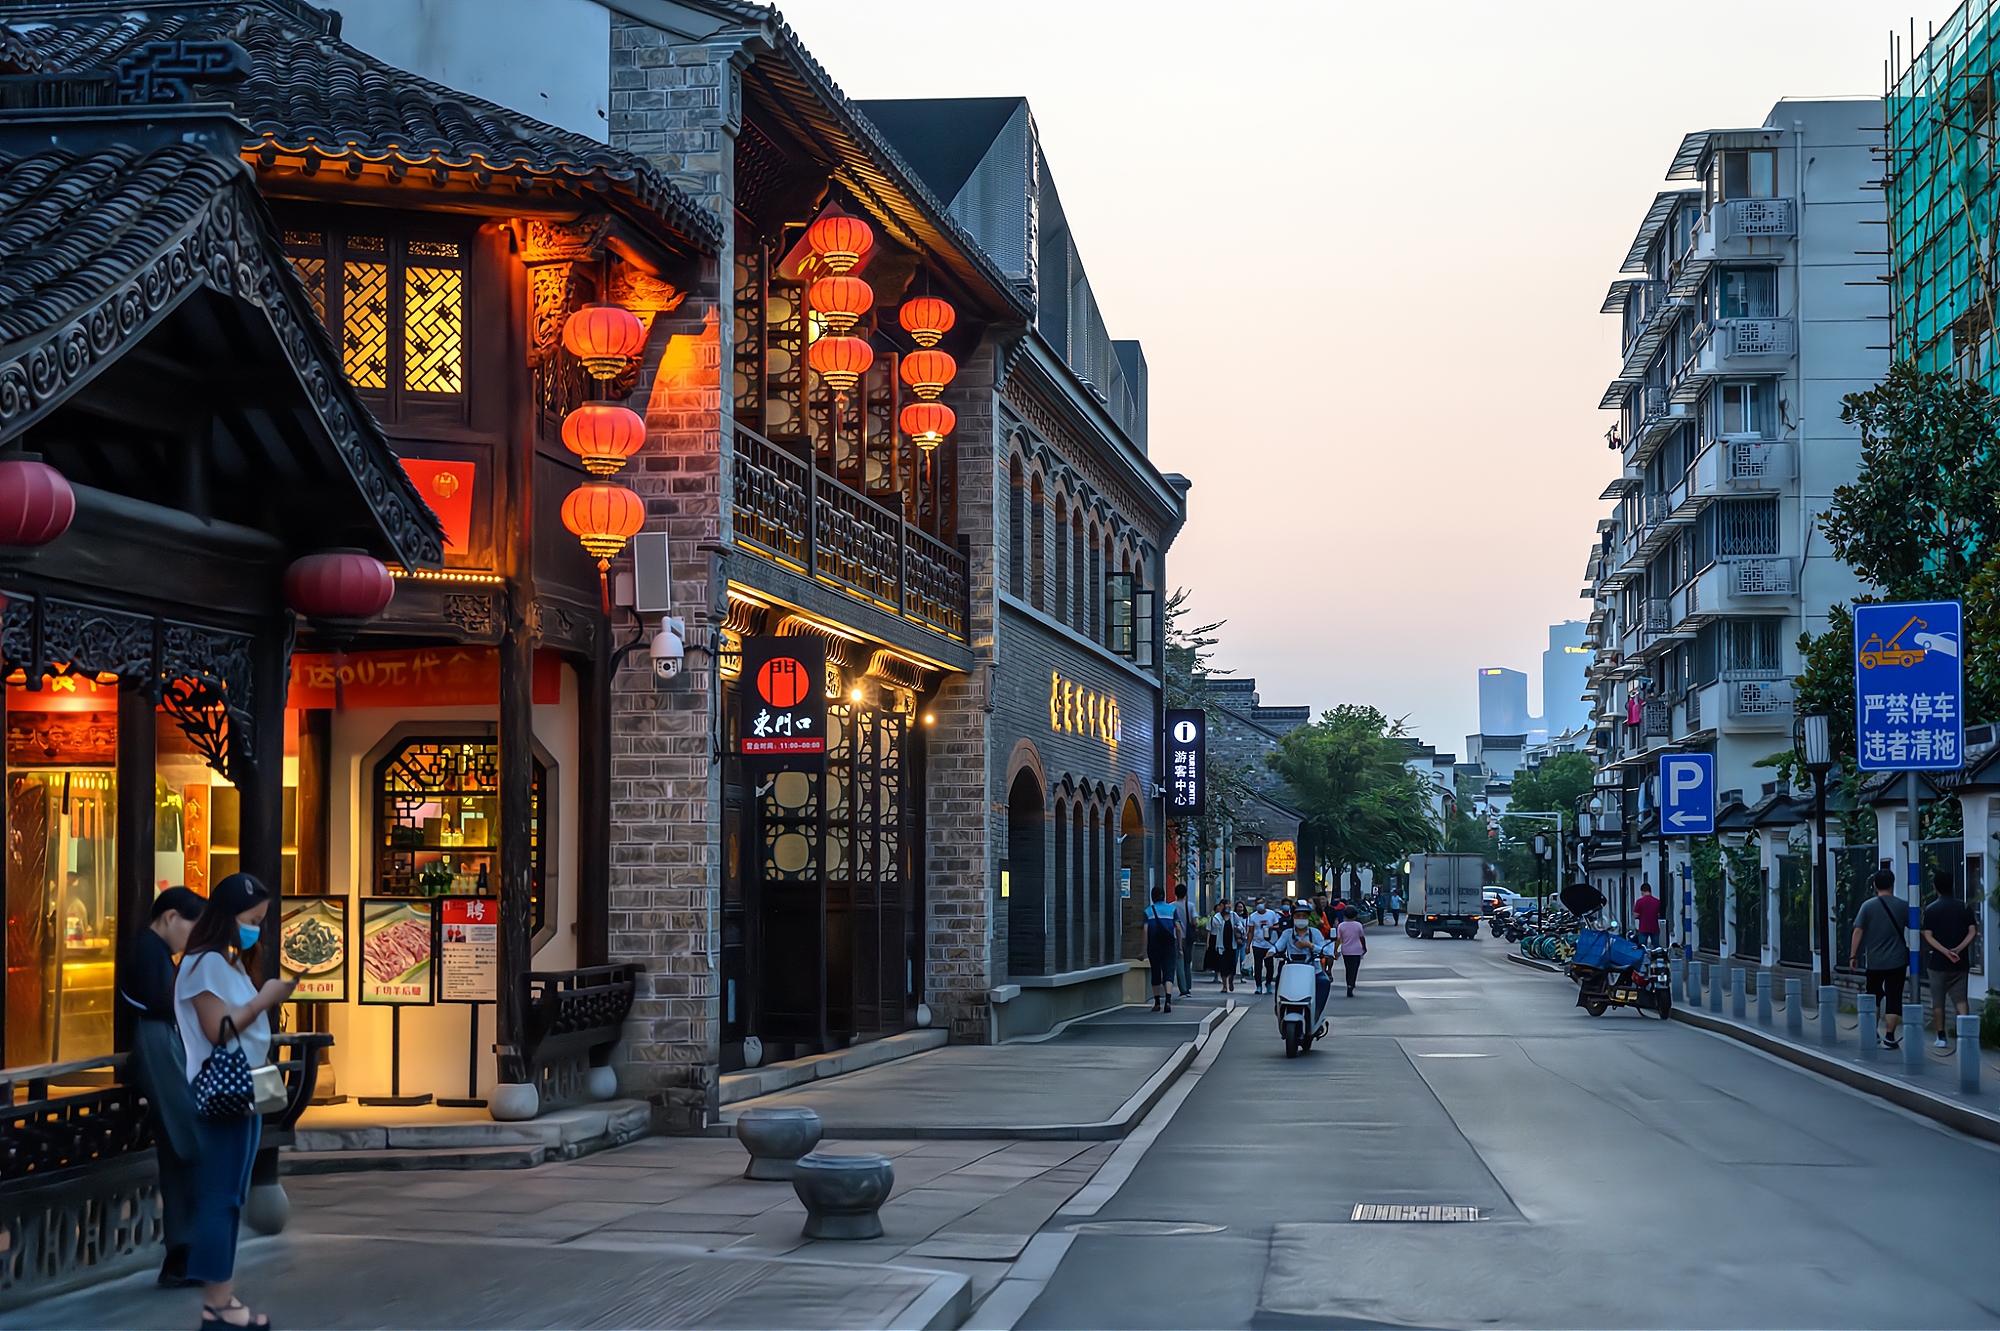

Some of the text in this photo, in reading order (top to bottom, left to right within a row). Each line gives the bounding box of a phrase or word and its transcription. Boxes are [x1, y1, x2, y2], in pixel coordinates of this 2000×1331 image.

[753, 708, 812, 737] 東門口
[1864, 692, 1955, 725] 严禁停车
[1864, 729, 1955, 761] 违者清拖
[1174, 750, 1188, 806] 游客中心
[1188, 750, 1196, 806] TOURIST CENTER
[1669, 761, 1704, 807] P
[466, 899, 486, 921] 聘
